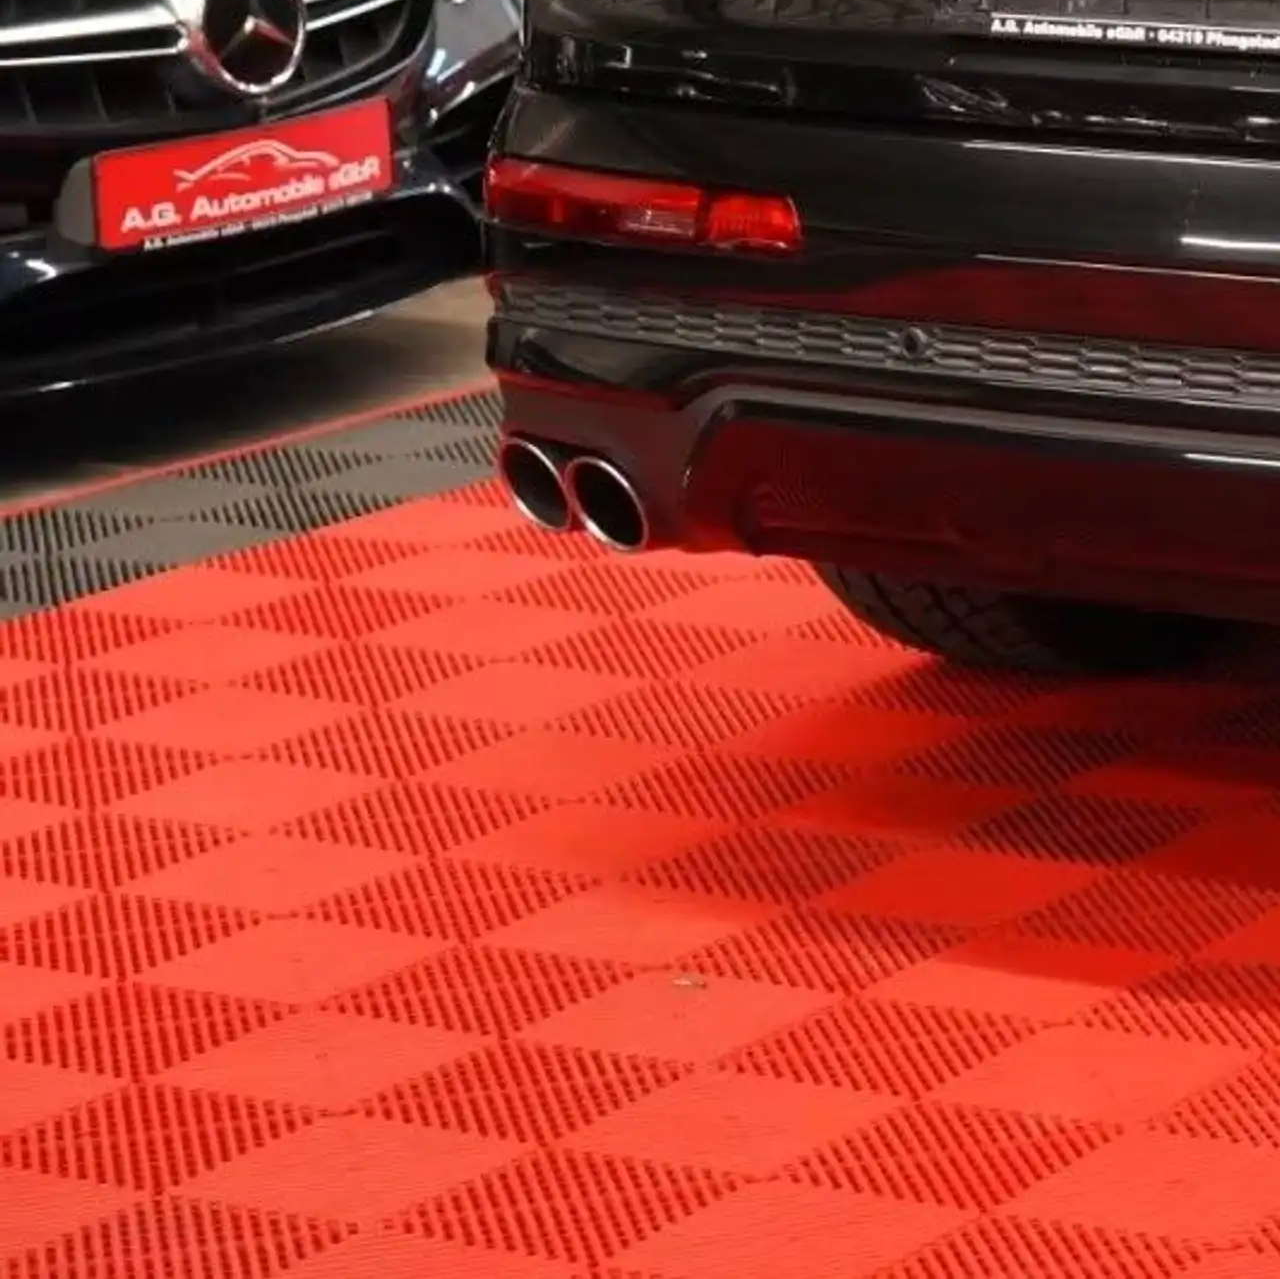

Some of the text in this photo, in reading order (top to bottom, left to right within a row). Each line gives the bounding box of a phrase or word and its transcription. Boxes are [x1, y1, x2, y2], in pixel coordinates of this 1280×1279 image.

[1023, 21, 1103, 39] Automobile
[120, 201, 182, 233] A.G.
[190, 174, 325, 221] Automobile
